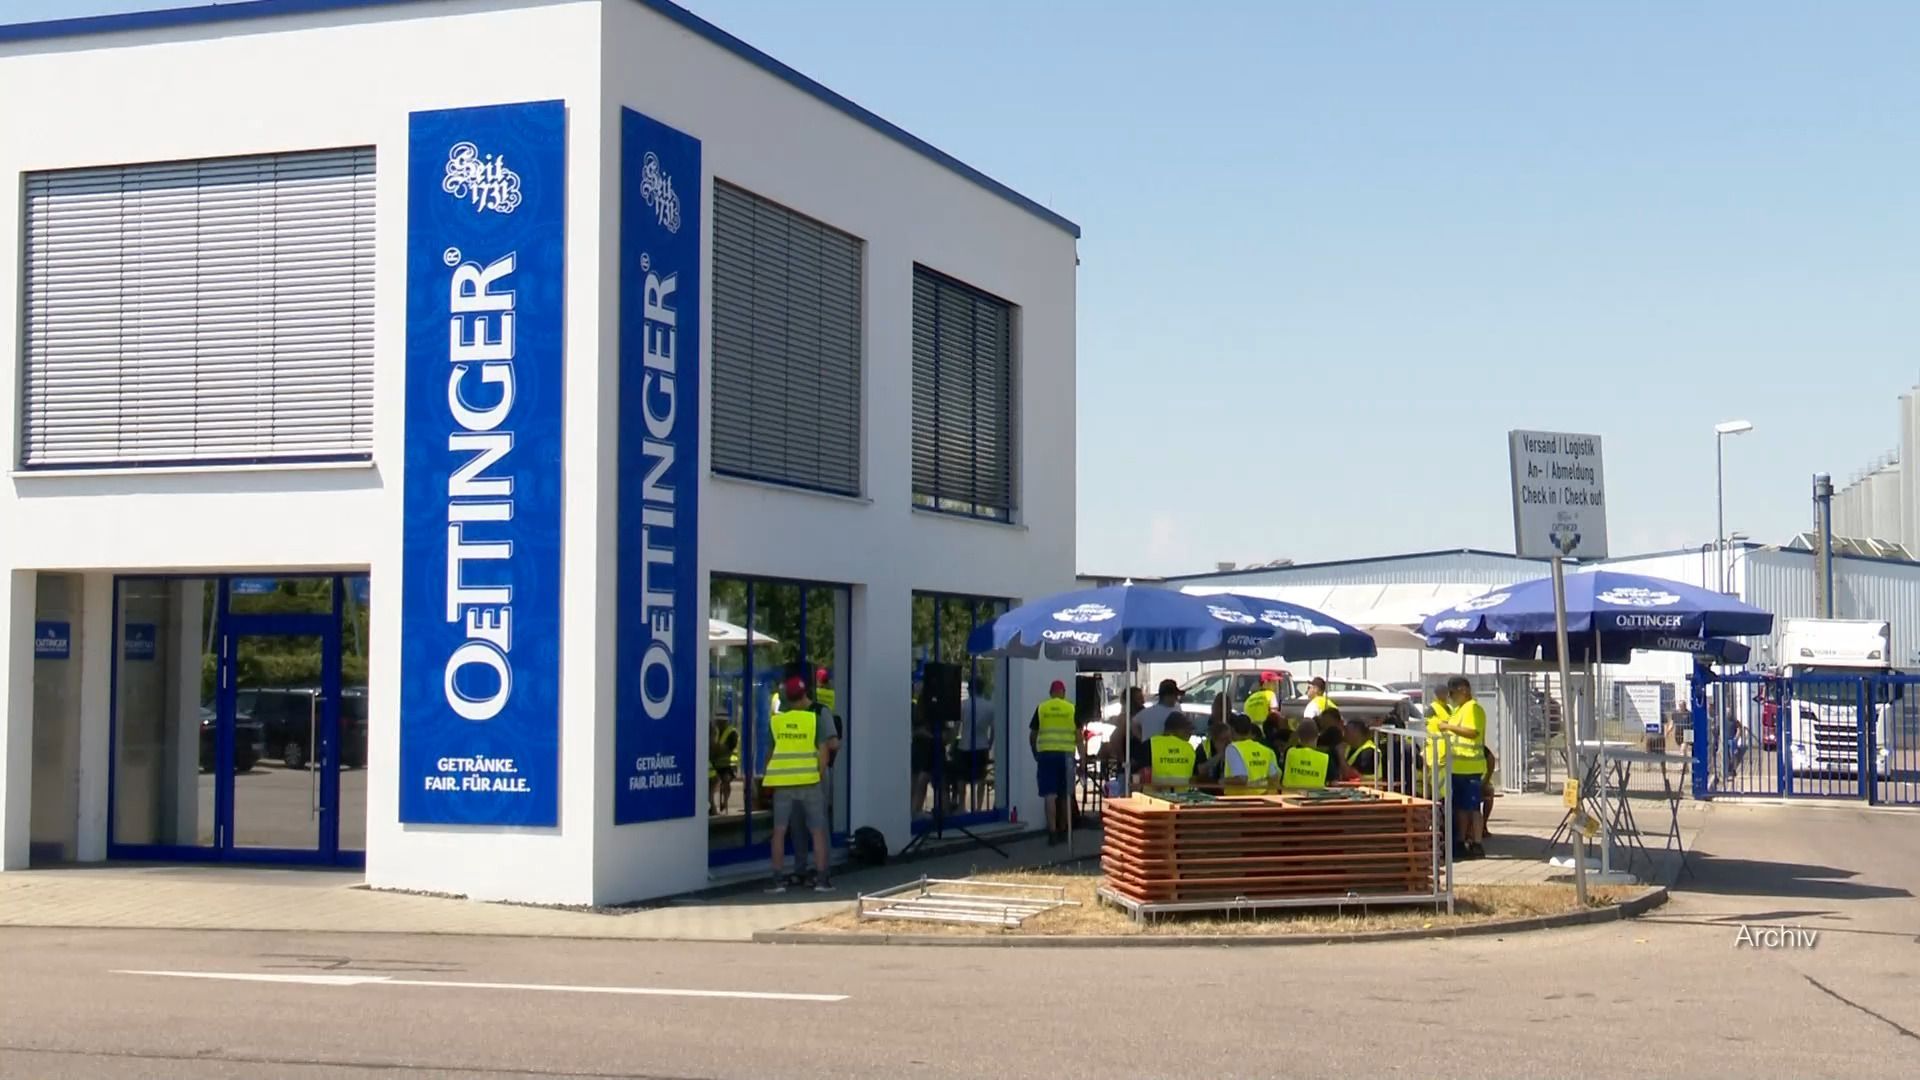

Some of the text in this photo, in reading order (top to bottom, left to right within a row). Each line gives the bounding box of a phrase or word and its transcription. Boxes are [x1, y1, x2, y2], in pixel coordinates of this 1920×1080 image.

[1523, 434, 1556, 454] Versand
[1564, 437, 1595, 459] Logistik
[1528, 460, 1543, 478] An-
[1551, 461, 1594, 485] Abmeldung
[444, 251, 516, 720] OETTINGER
[640, 271, 677, 720] OETTINGER
[1522, 485, 1547, 504] Check
[1549, 486, 1557, 503] in
[1564, 487, 1589, 506] Check
[1590, 489, 1603, 506] out
[437, 755, 518, 773] GETRÄNKE.
[636, 753, 677, 770] GETRÄNKE.
[425, 774, 531, 792] FAIR. FÜR ALLE.
[630, 772, 684, 791] FAIR. FÜR ALLE.
